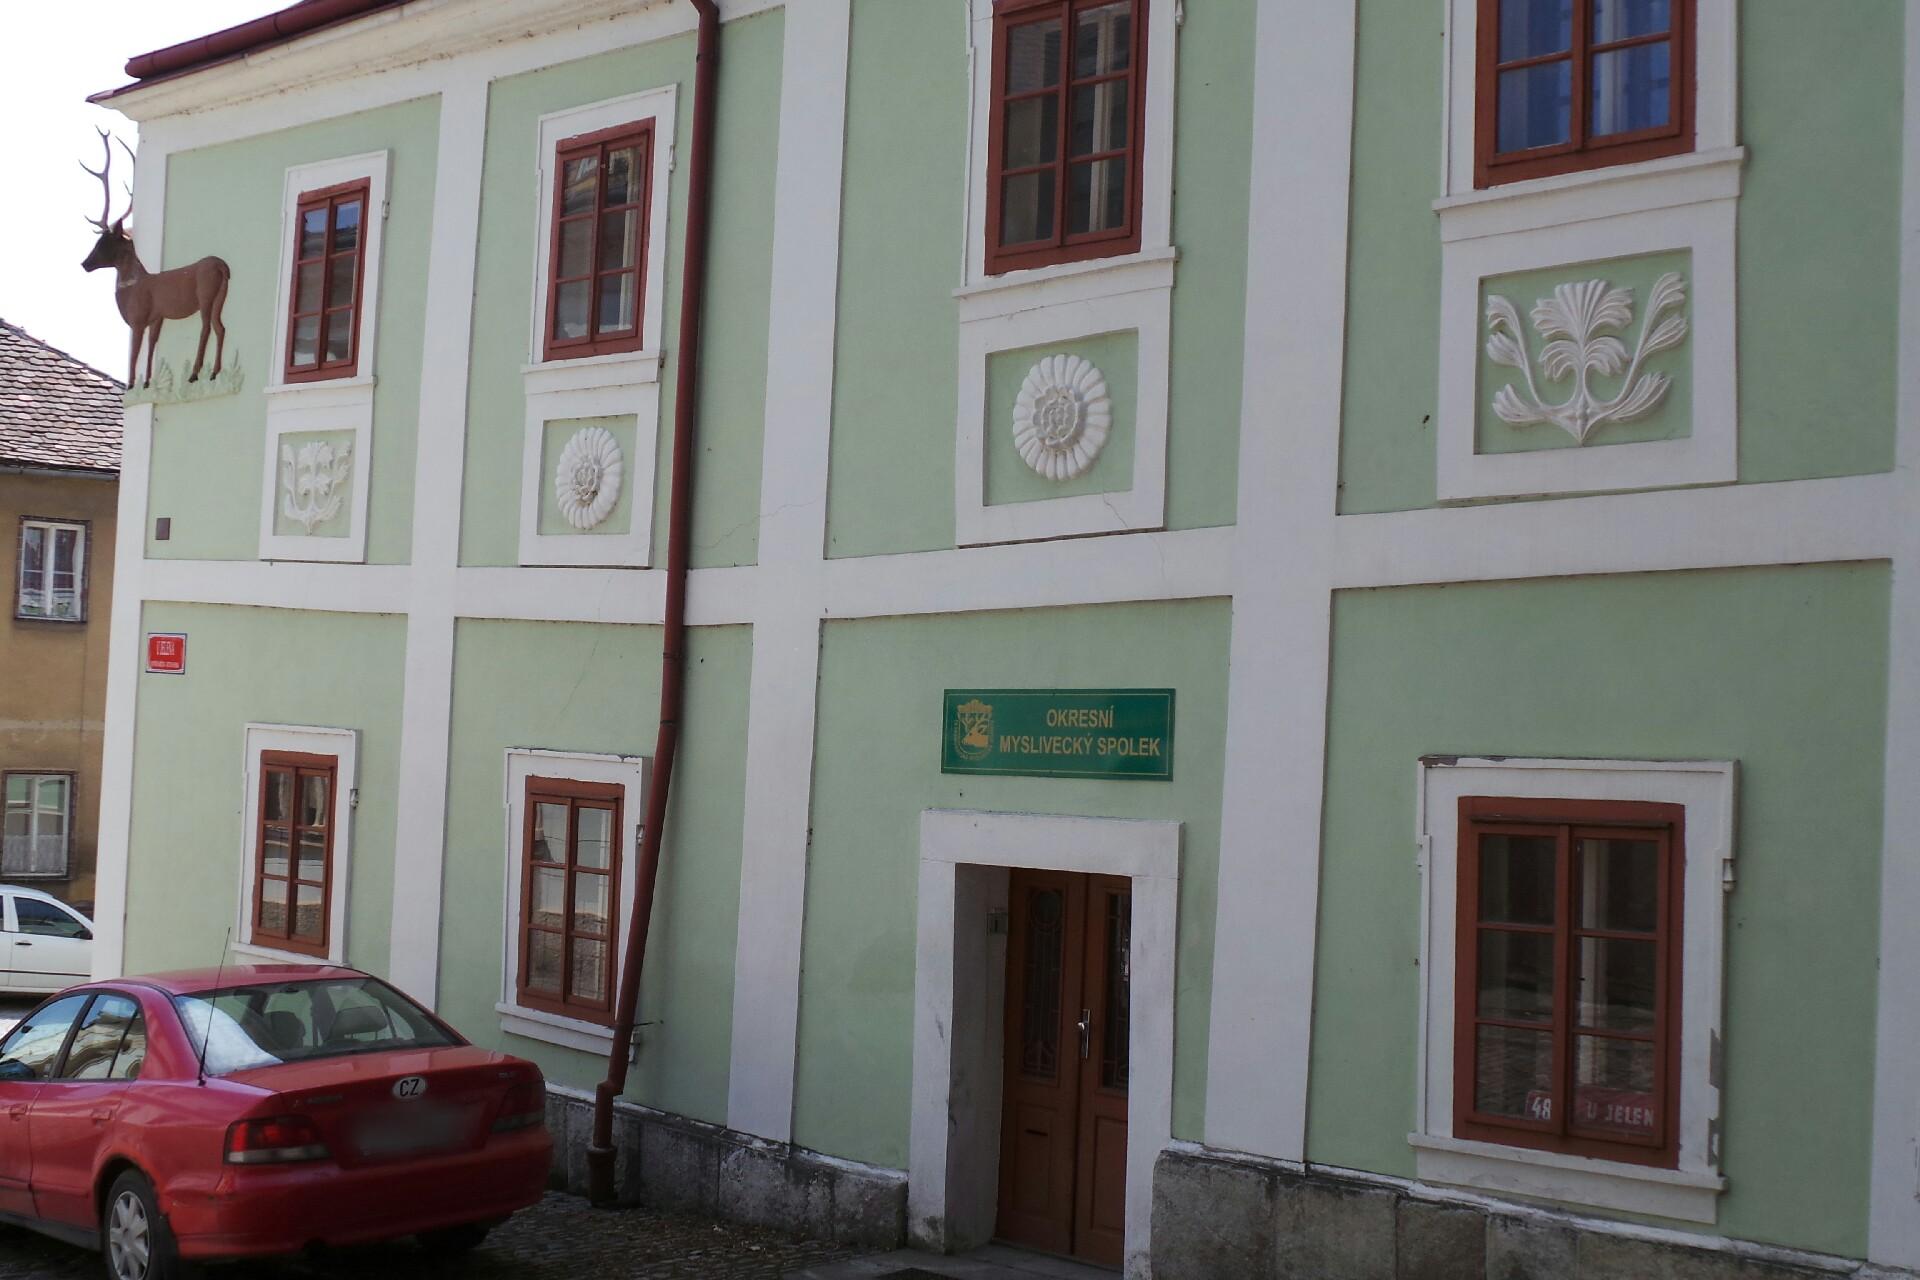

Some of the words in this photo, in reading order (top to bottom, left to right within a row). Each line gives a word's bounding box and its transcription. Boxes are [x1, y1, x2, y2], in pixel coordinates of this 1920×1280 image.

[1046, 705, 1115, 729] OKRESNÍ
[999, 733, 1093, 756] MYSLIVECKÝ
[1097, 737, 1161, 757] SPOLEK
[399, 1078, 420, 1098] CZ
